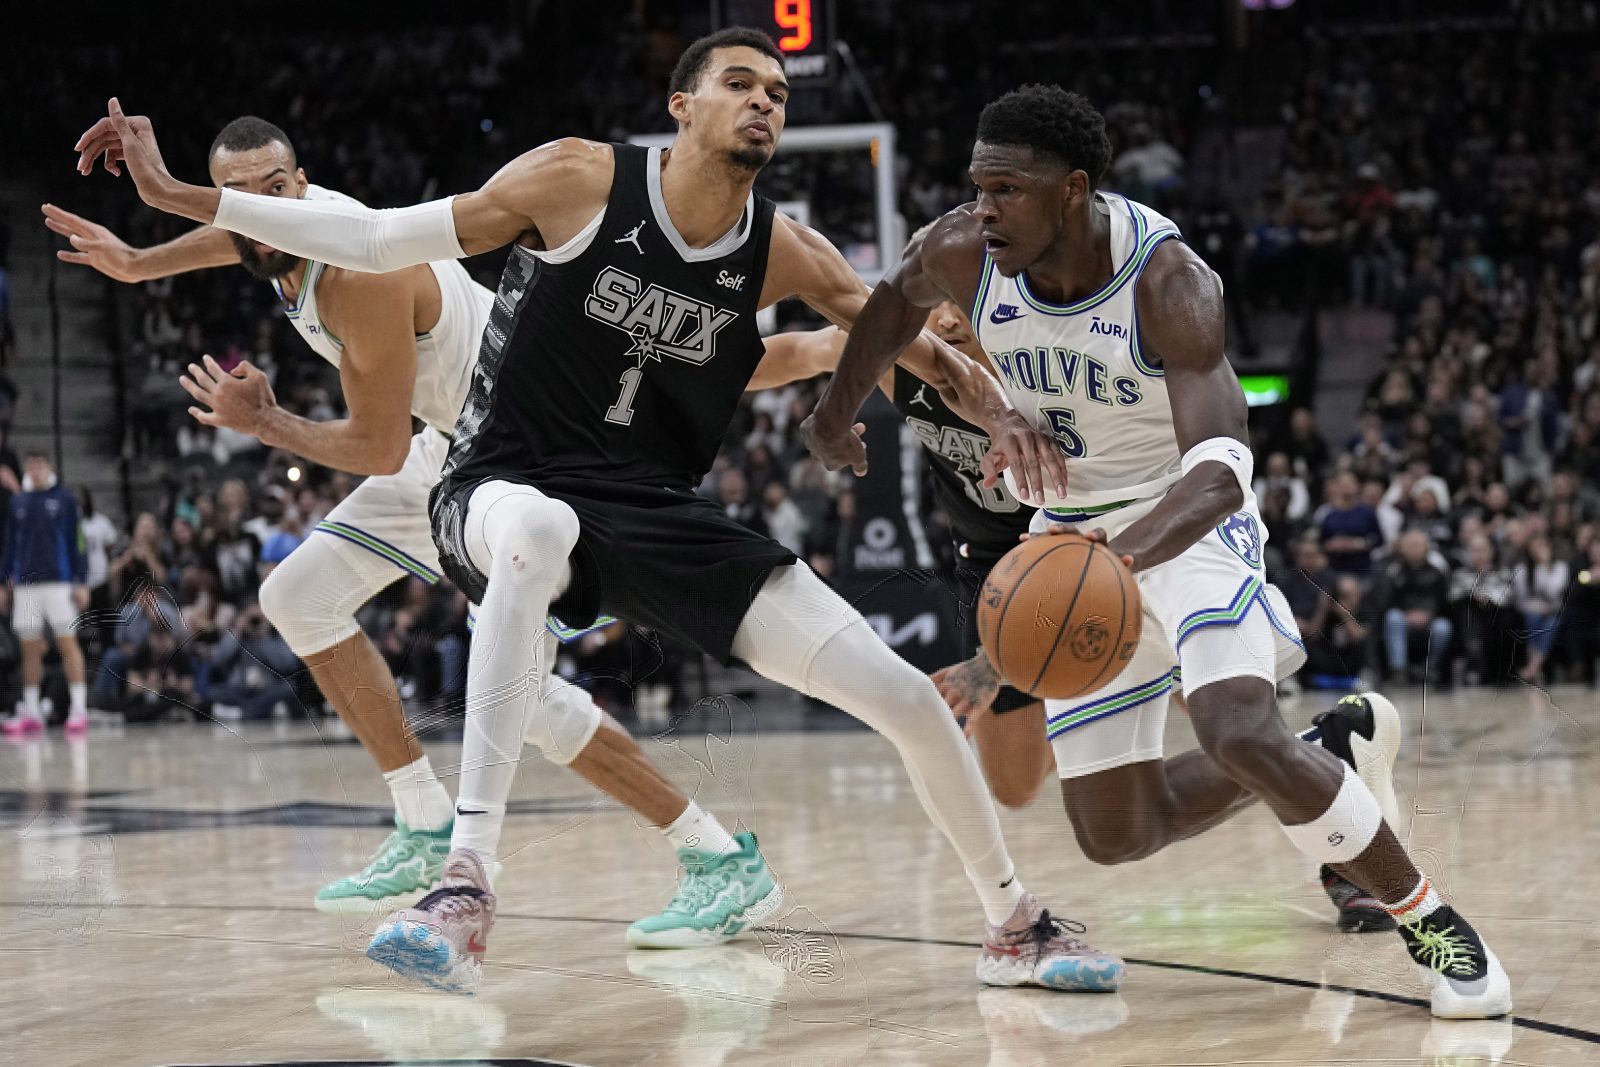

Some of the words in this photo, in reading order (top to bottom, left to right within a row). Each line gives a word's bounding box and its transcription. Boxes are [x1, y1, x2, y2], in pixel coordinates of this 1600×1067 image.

[774, 0, 812, 51] 9
[585, 265, 739, 366] SATX
[996, 303, 1020, 318] NIKE
[604, 367, 643, 425] 1
[990, 347, 1143, 406] WOLVES
[906, 416, 991, 466] SAT
[1040, 407, 1088, 458] 5
